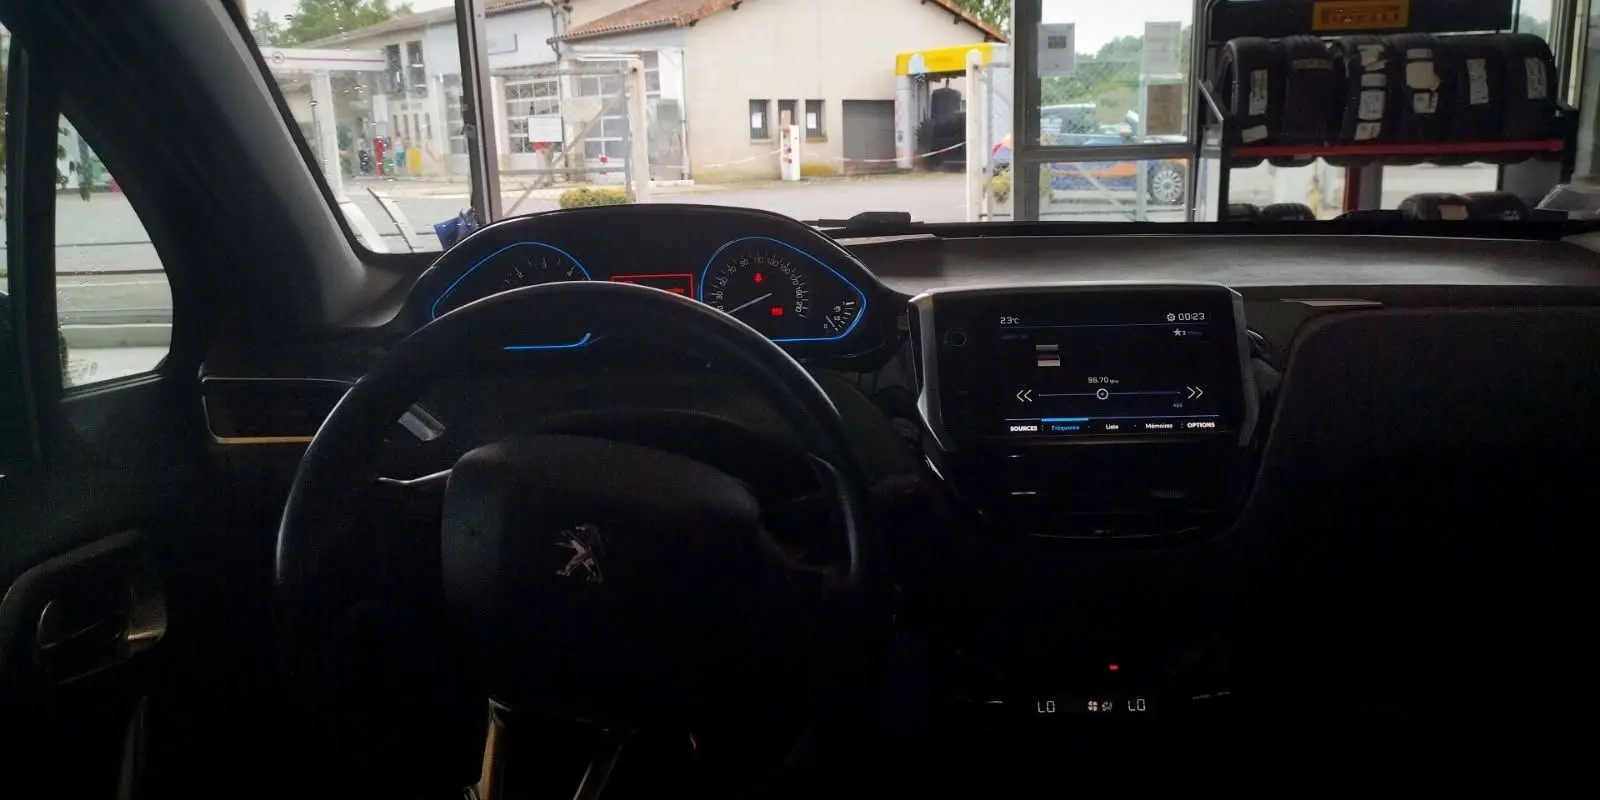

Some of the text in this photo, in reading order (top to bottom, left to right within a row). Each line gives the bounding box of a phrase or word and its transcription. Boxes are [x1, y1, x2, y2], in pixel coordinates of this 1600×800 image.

[1178, 312, 1206, 321] 00:23
[1009, 424, 1039, 432] SOURCES
[1105, 423, 1119, 431] Liste
[1186, 420, 1216, 429] OPTIONS
